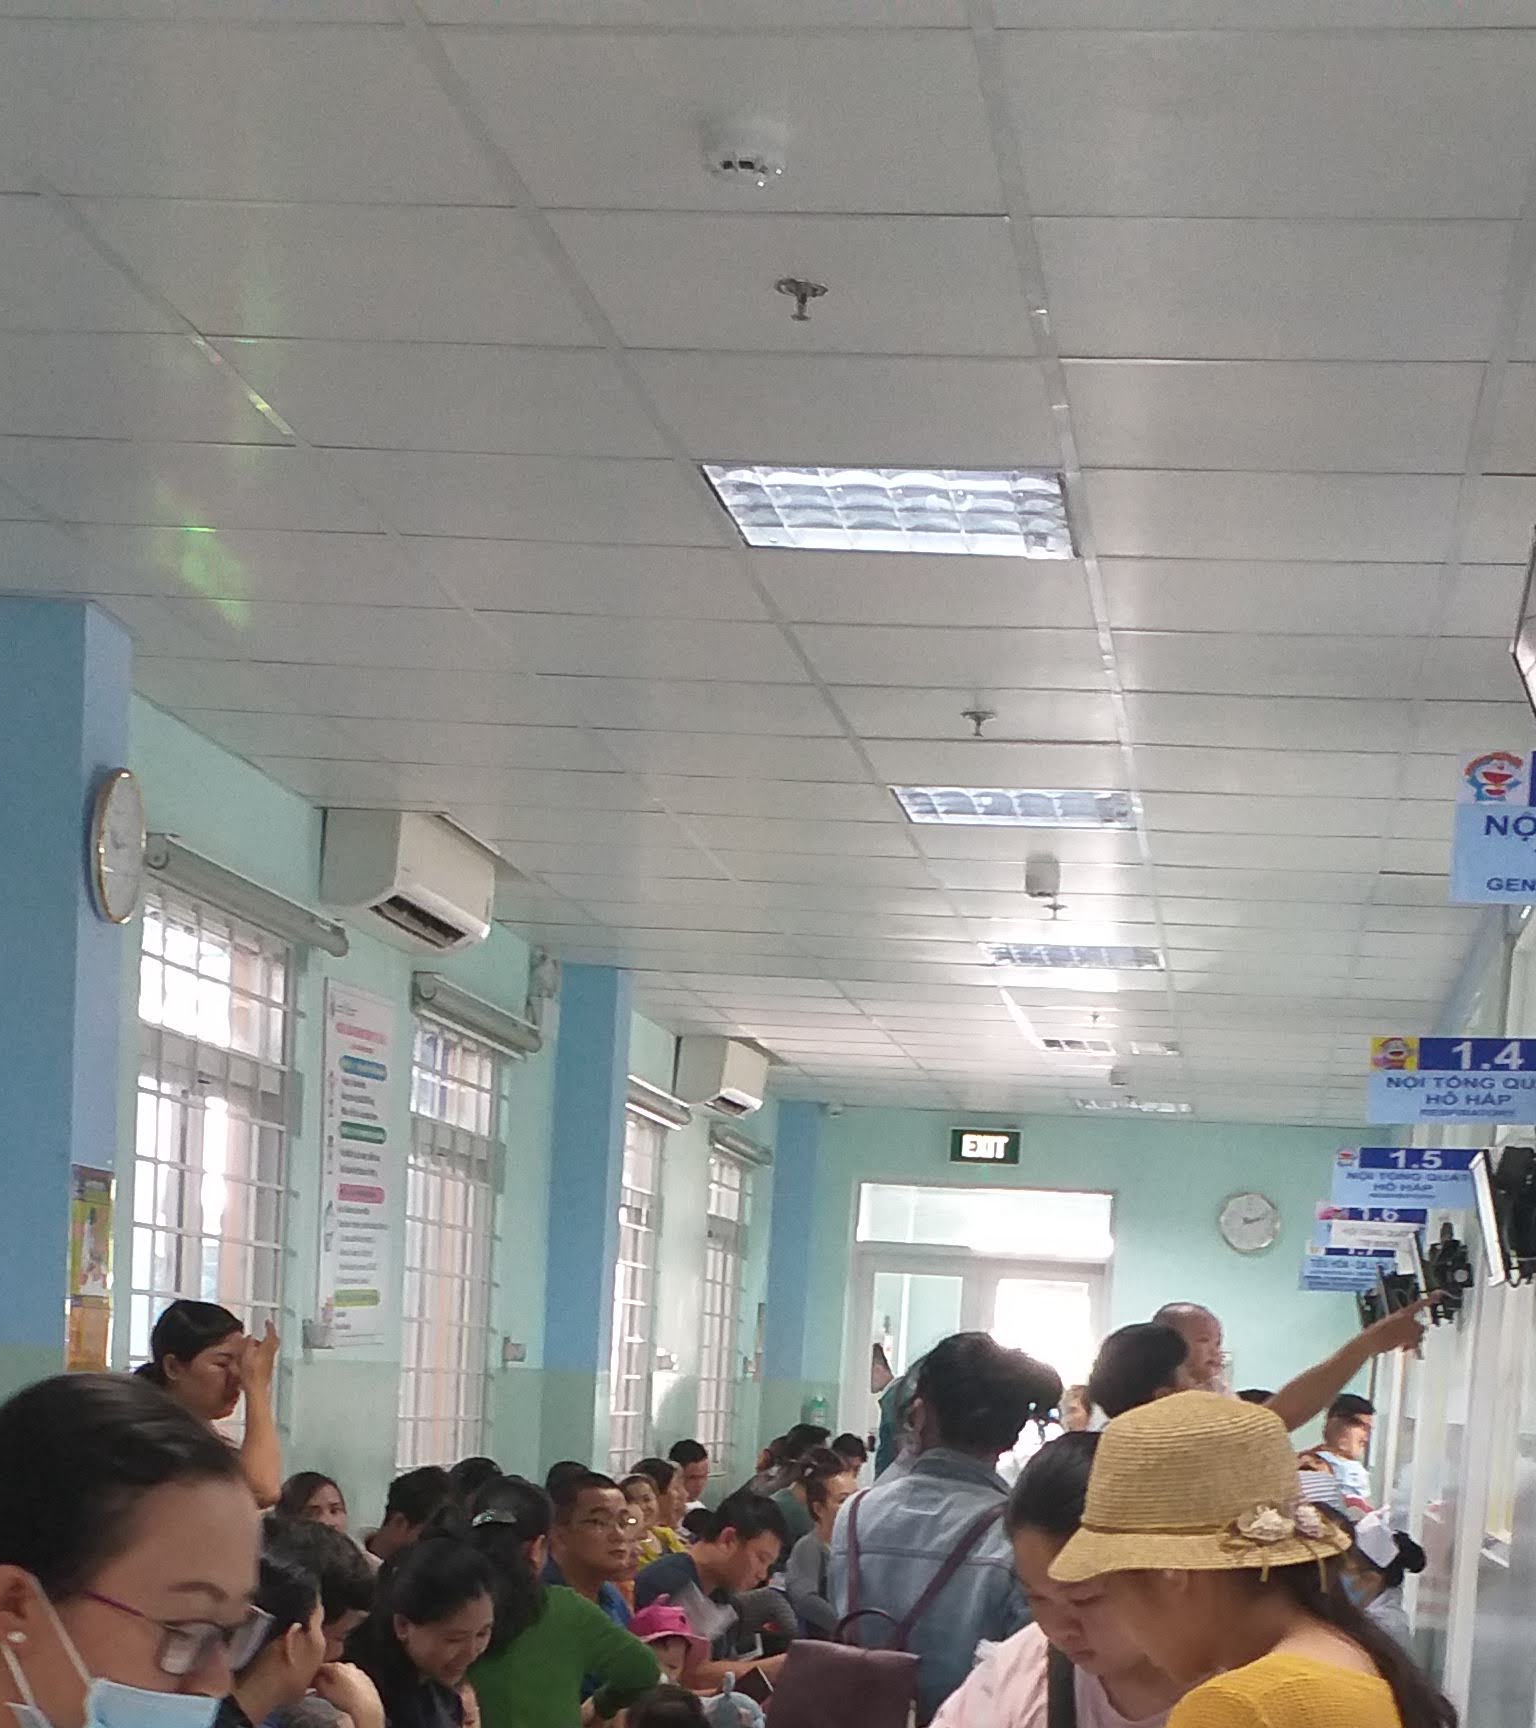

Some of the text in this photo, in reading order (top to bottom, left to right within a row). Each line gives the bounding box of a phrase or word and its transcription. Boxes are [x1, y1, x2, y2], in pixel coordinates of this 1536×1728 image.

[1451, 1041, 1524, 1070] 1.4
[1387, 1077, 1425, 1091] NỘI
[1433, 1075, 1495, 1090] TỔNG
[1426, 1092, 1458, 1105] HÔ
[962, 1133, 1009, 1158] EXIT
[1389, 1150, 1442, 1169] 1.5
